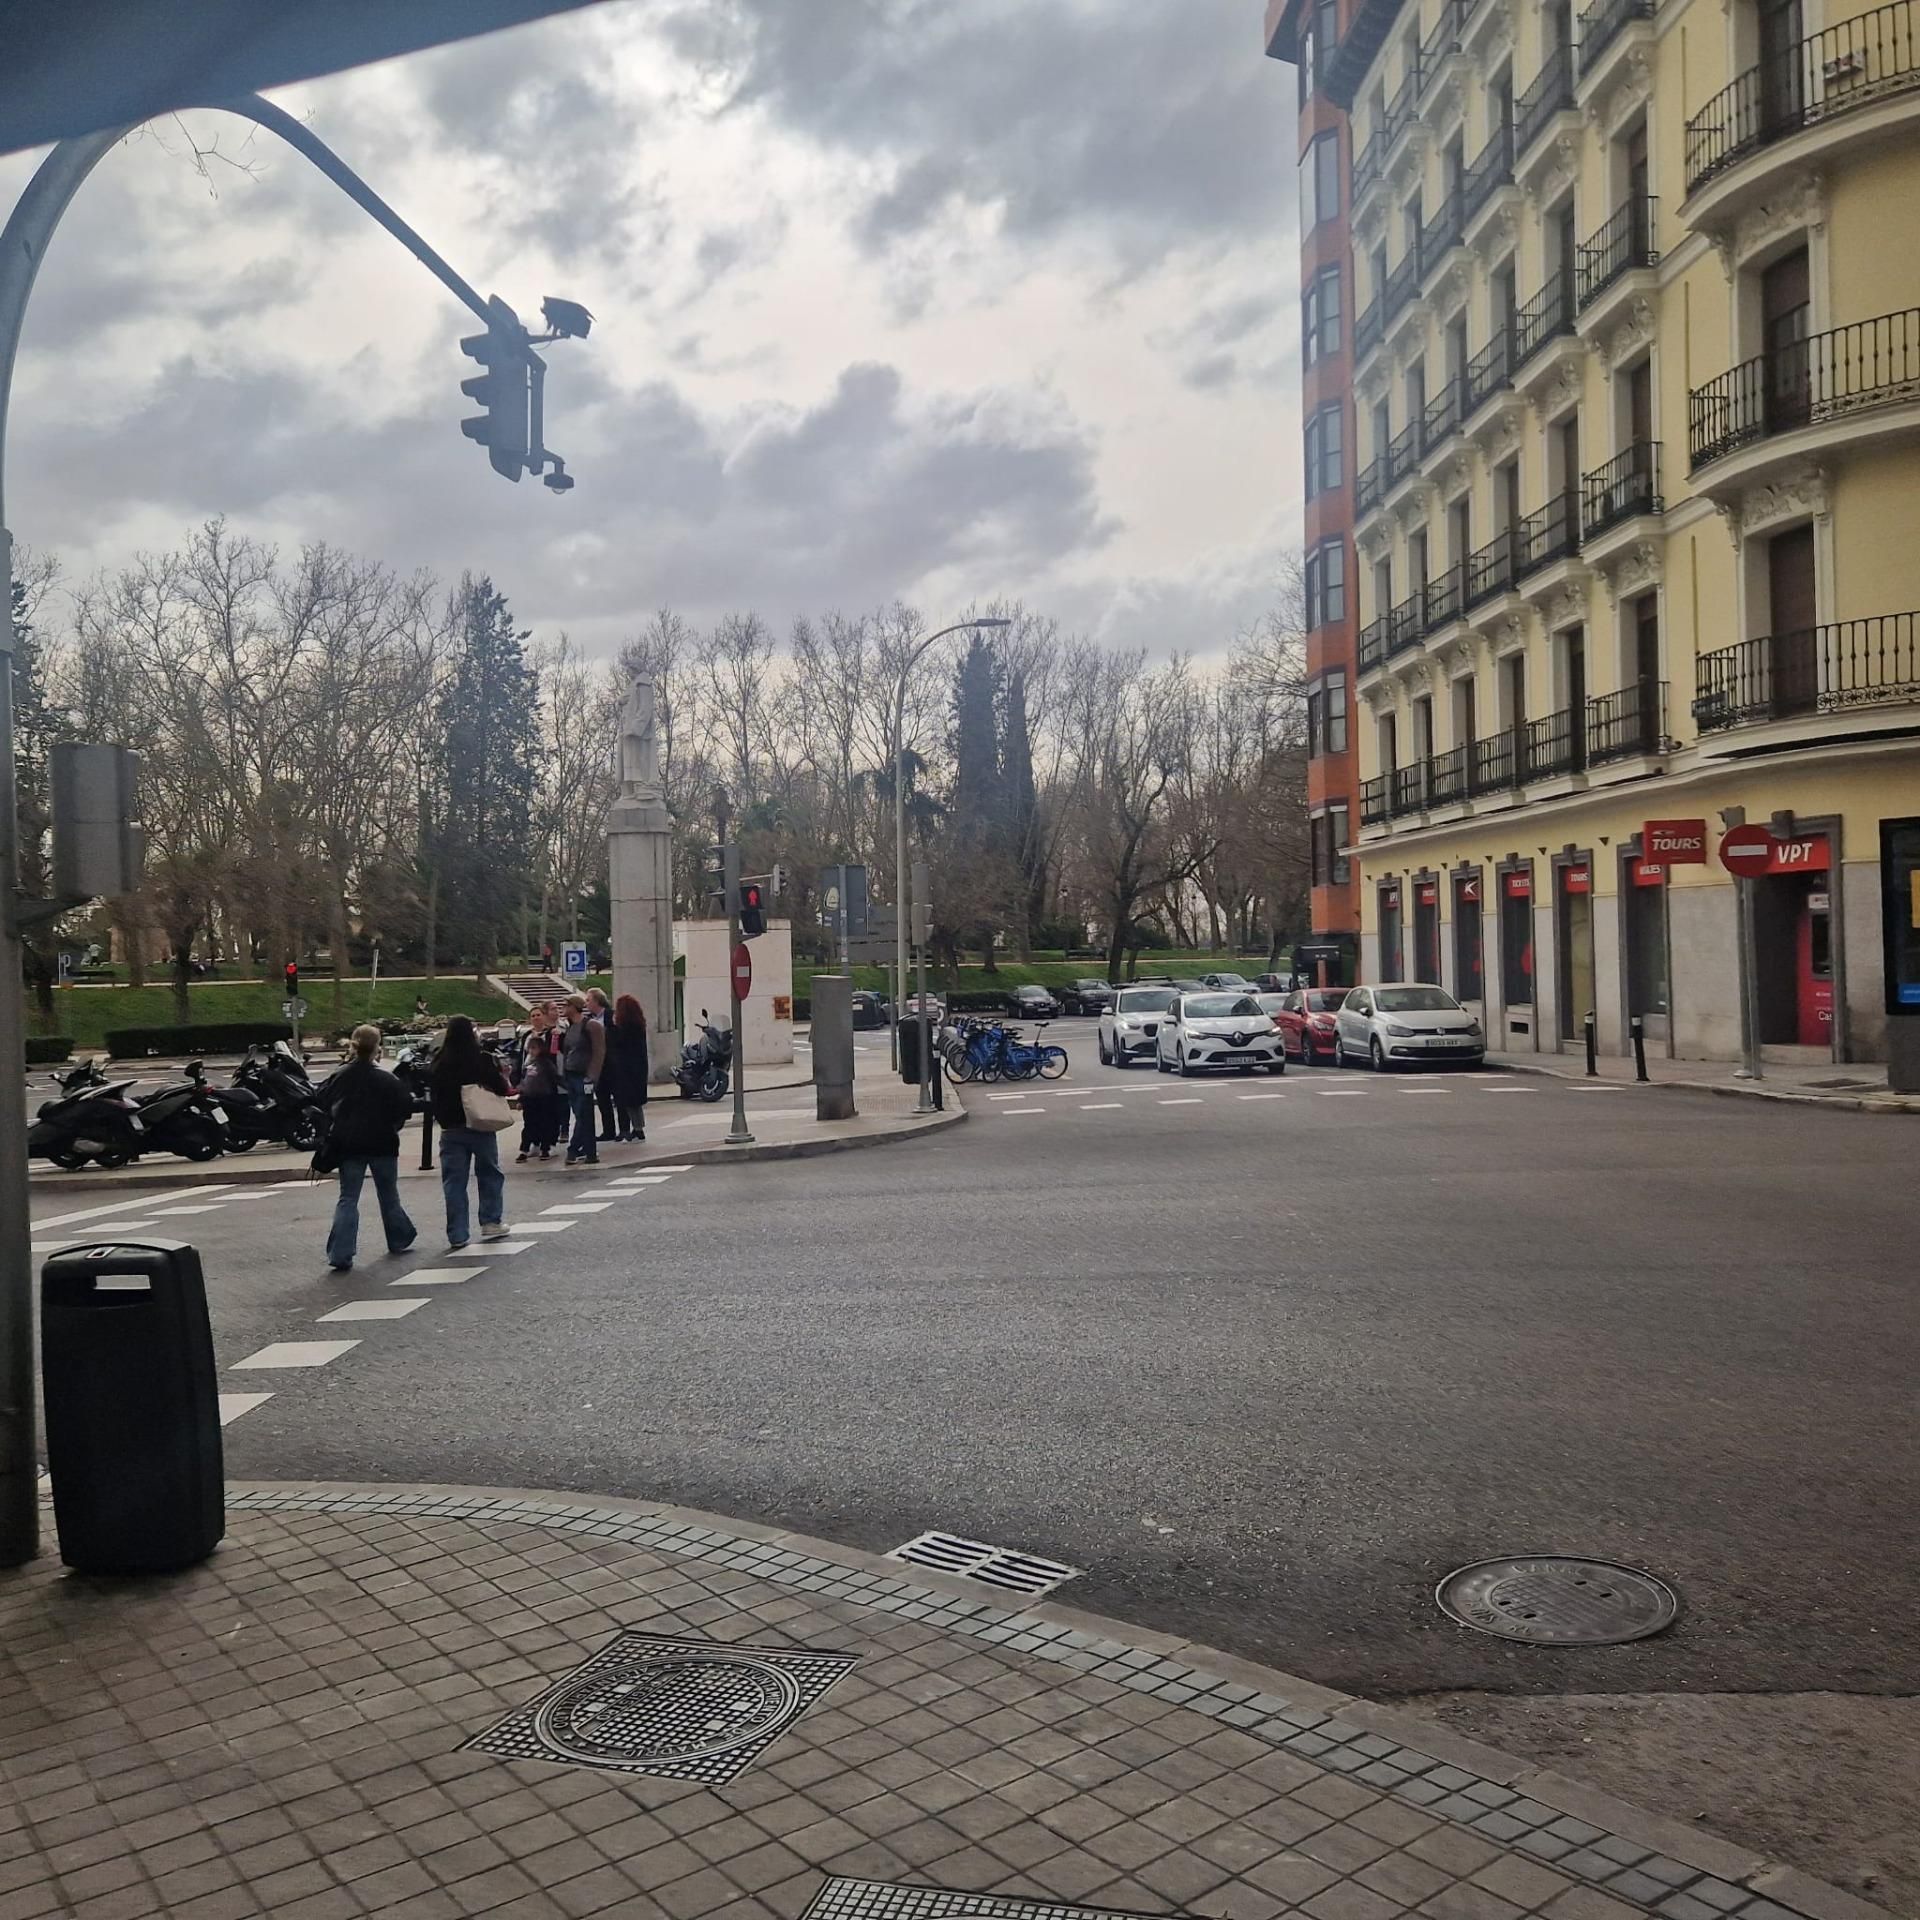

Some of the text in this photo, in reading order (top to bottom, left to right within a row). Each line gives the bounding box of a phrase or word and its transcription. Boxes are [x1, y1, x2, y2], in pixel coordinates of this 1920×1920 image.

[1652, 837, 1702, 851] TOURS
[1778, 842, 1813, 864] VPT
[568, 952, 580, 971] P
[623, 1739, 707, 1758] MADRID
